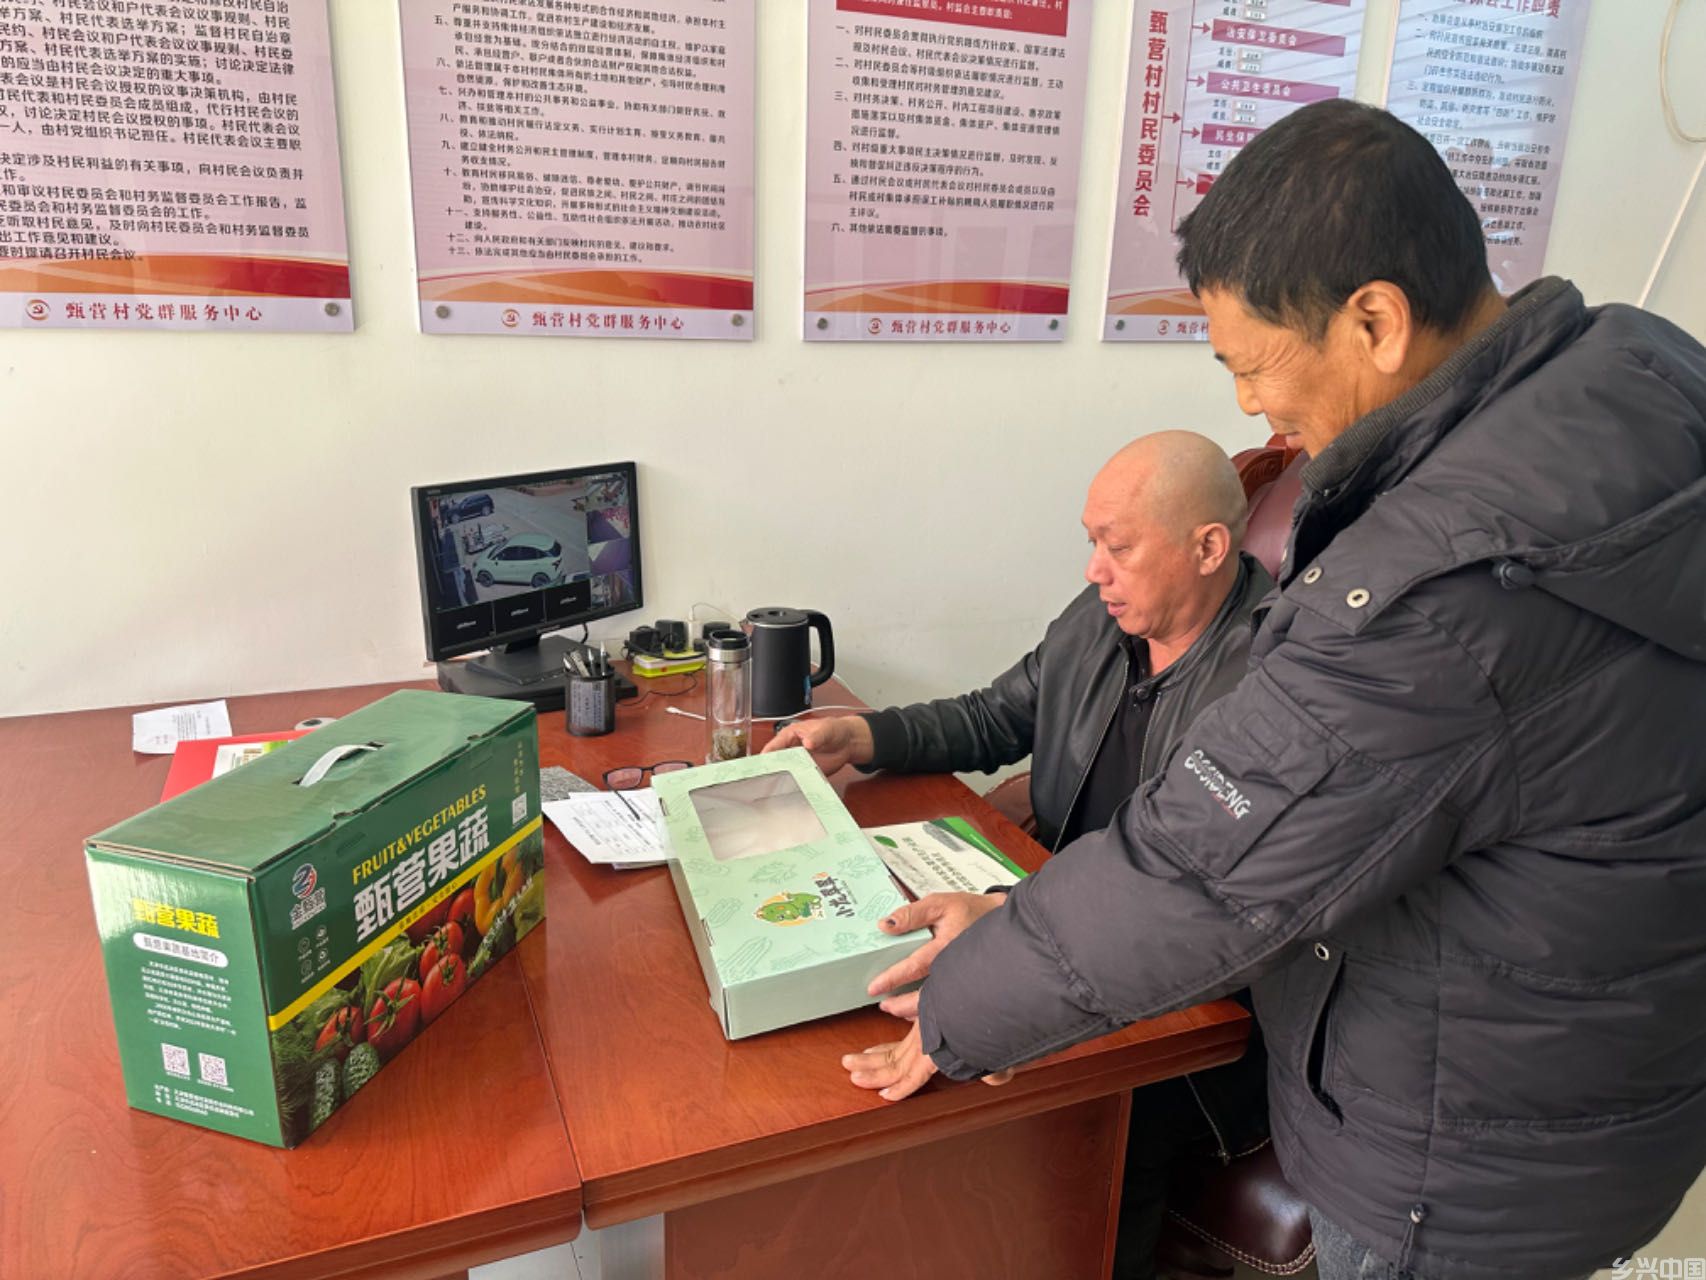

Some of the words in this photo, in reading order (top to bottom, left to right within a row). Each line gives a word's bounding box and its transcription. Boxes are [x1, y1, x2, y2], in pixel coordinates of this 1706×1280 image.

[1, 56, 222, 85] 的应当由村民会议决定的重大事项。
[0, 72, 297, 106] 表会议是村民会议授权的议事决策机构，由村民
[1133, 10, 1169, 216] 甄营村村民委员会
[0, 168, 26, 182] 作。
[65, 302, 263, 322] 甄营村党群服务中心
[532, 311, 685, 330] 甄营村党群服务中心
[891, 319, 1012, 335] 甄营村党群服务中心
[352, 784, 487, 885] FRUIT&VEGETABLES
[353, 804, 490, 943] 甄营果蔬
